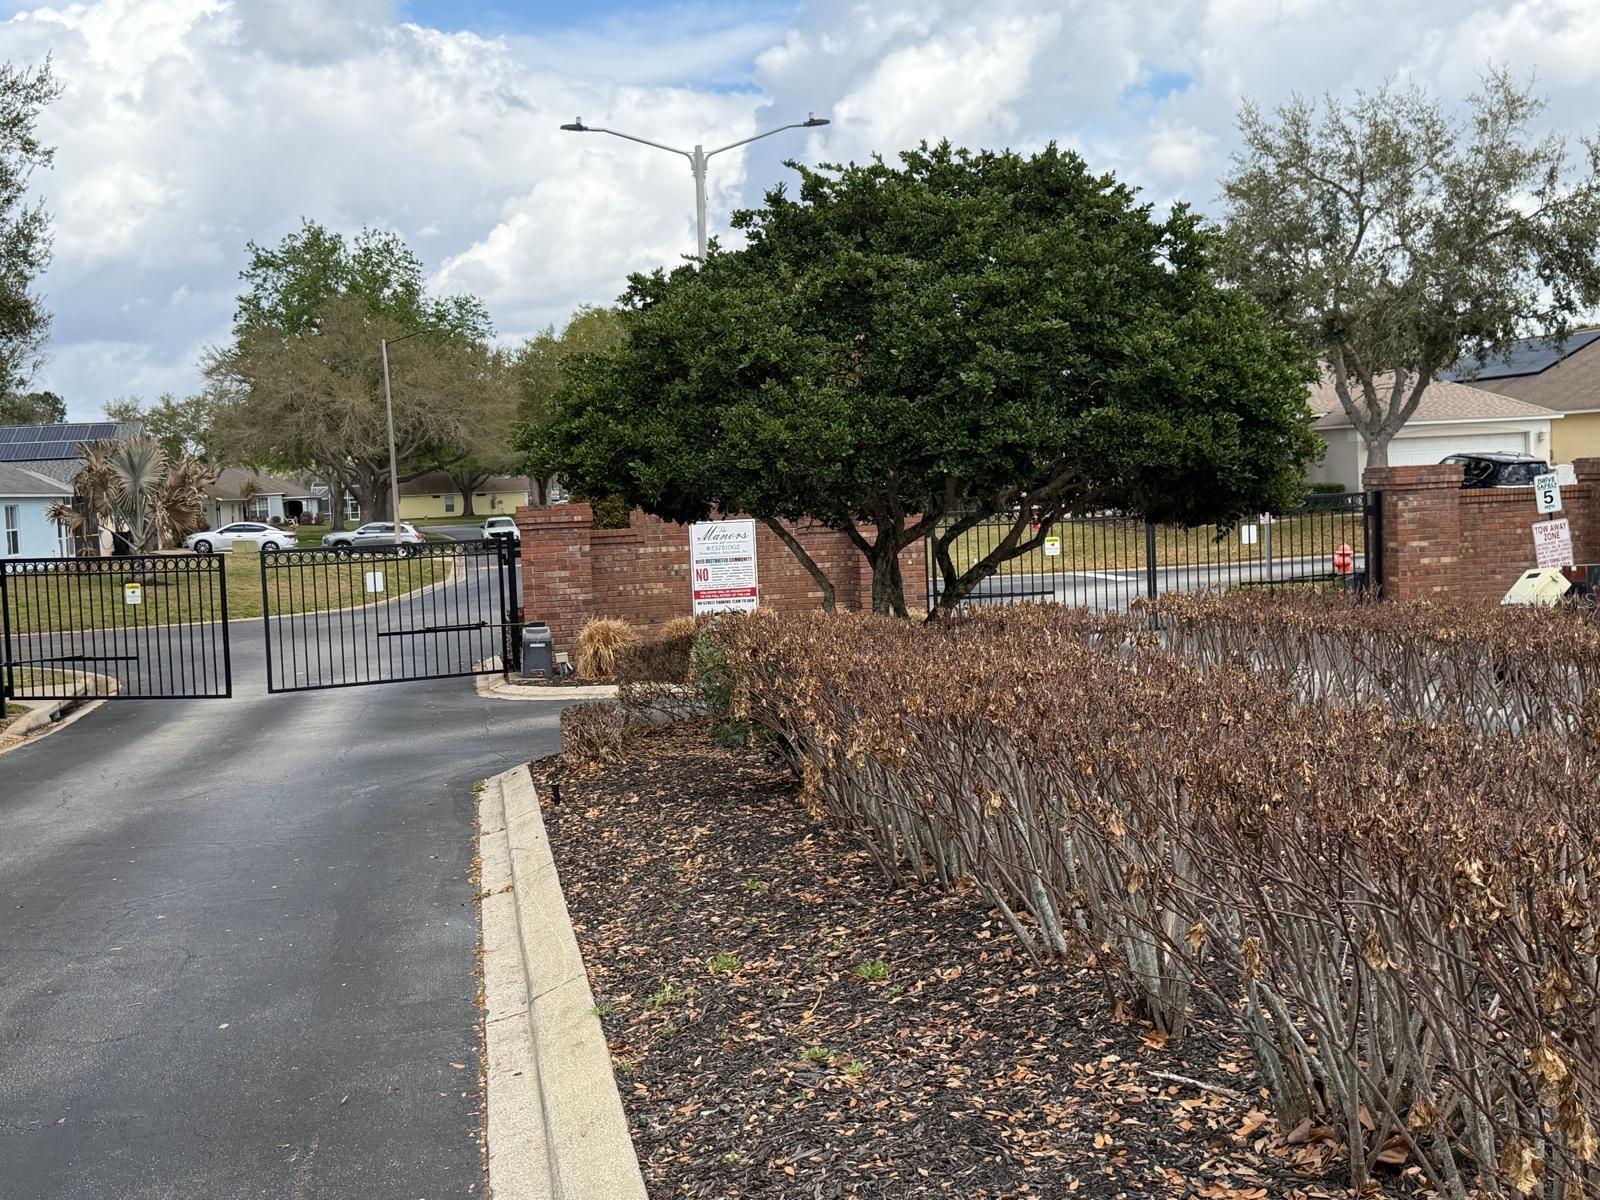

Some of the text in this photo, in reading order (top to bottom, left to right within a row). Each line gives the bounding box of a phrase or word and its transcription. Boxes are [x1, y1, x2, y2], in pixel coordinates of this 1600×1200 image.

[1537, 482, 1558, 490] SAFELY
[1544, 490, 1554, 504] 5
[698, 525, 748, 541] Manors
[1534, 522, 1566, 534] TOW AWAY
[1544, 531, 1560, 541] ZONE
[696, 568, 709, 582] NO
